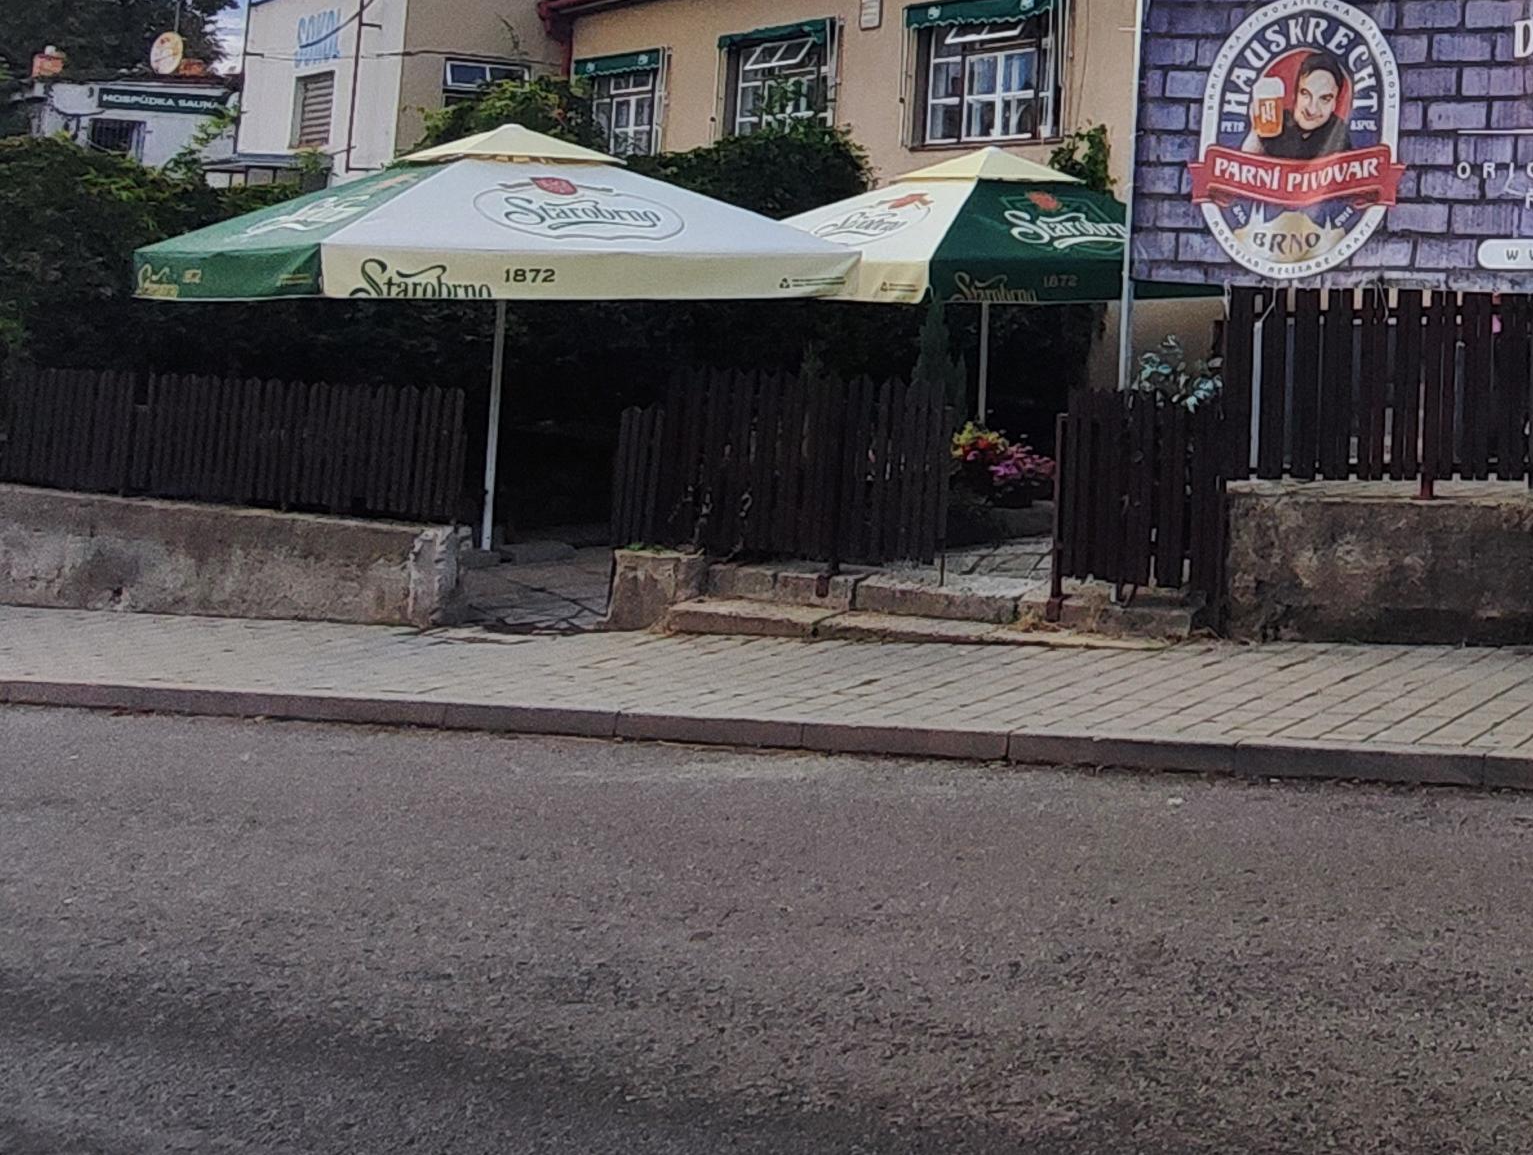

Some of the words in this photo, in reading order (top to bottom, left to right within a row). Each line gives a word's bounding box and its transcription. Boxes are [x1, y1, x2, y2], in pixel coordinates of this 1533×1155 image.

[1222, 17, 1379, 116] HAUSKRECHT
[1214, 157, 1281, 190] PARNÍ
[1286, 157, 1380, 193] PIVOVAR
[503, 196, 662, 230] Starobrno
[1252, 231, 1321, 255] BRNO
[350, 258, 493, 297] Starobrno
[503, 268, 556, 283] 1872
[1043, 274, 1079, 287] 1872
